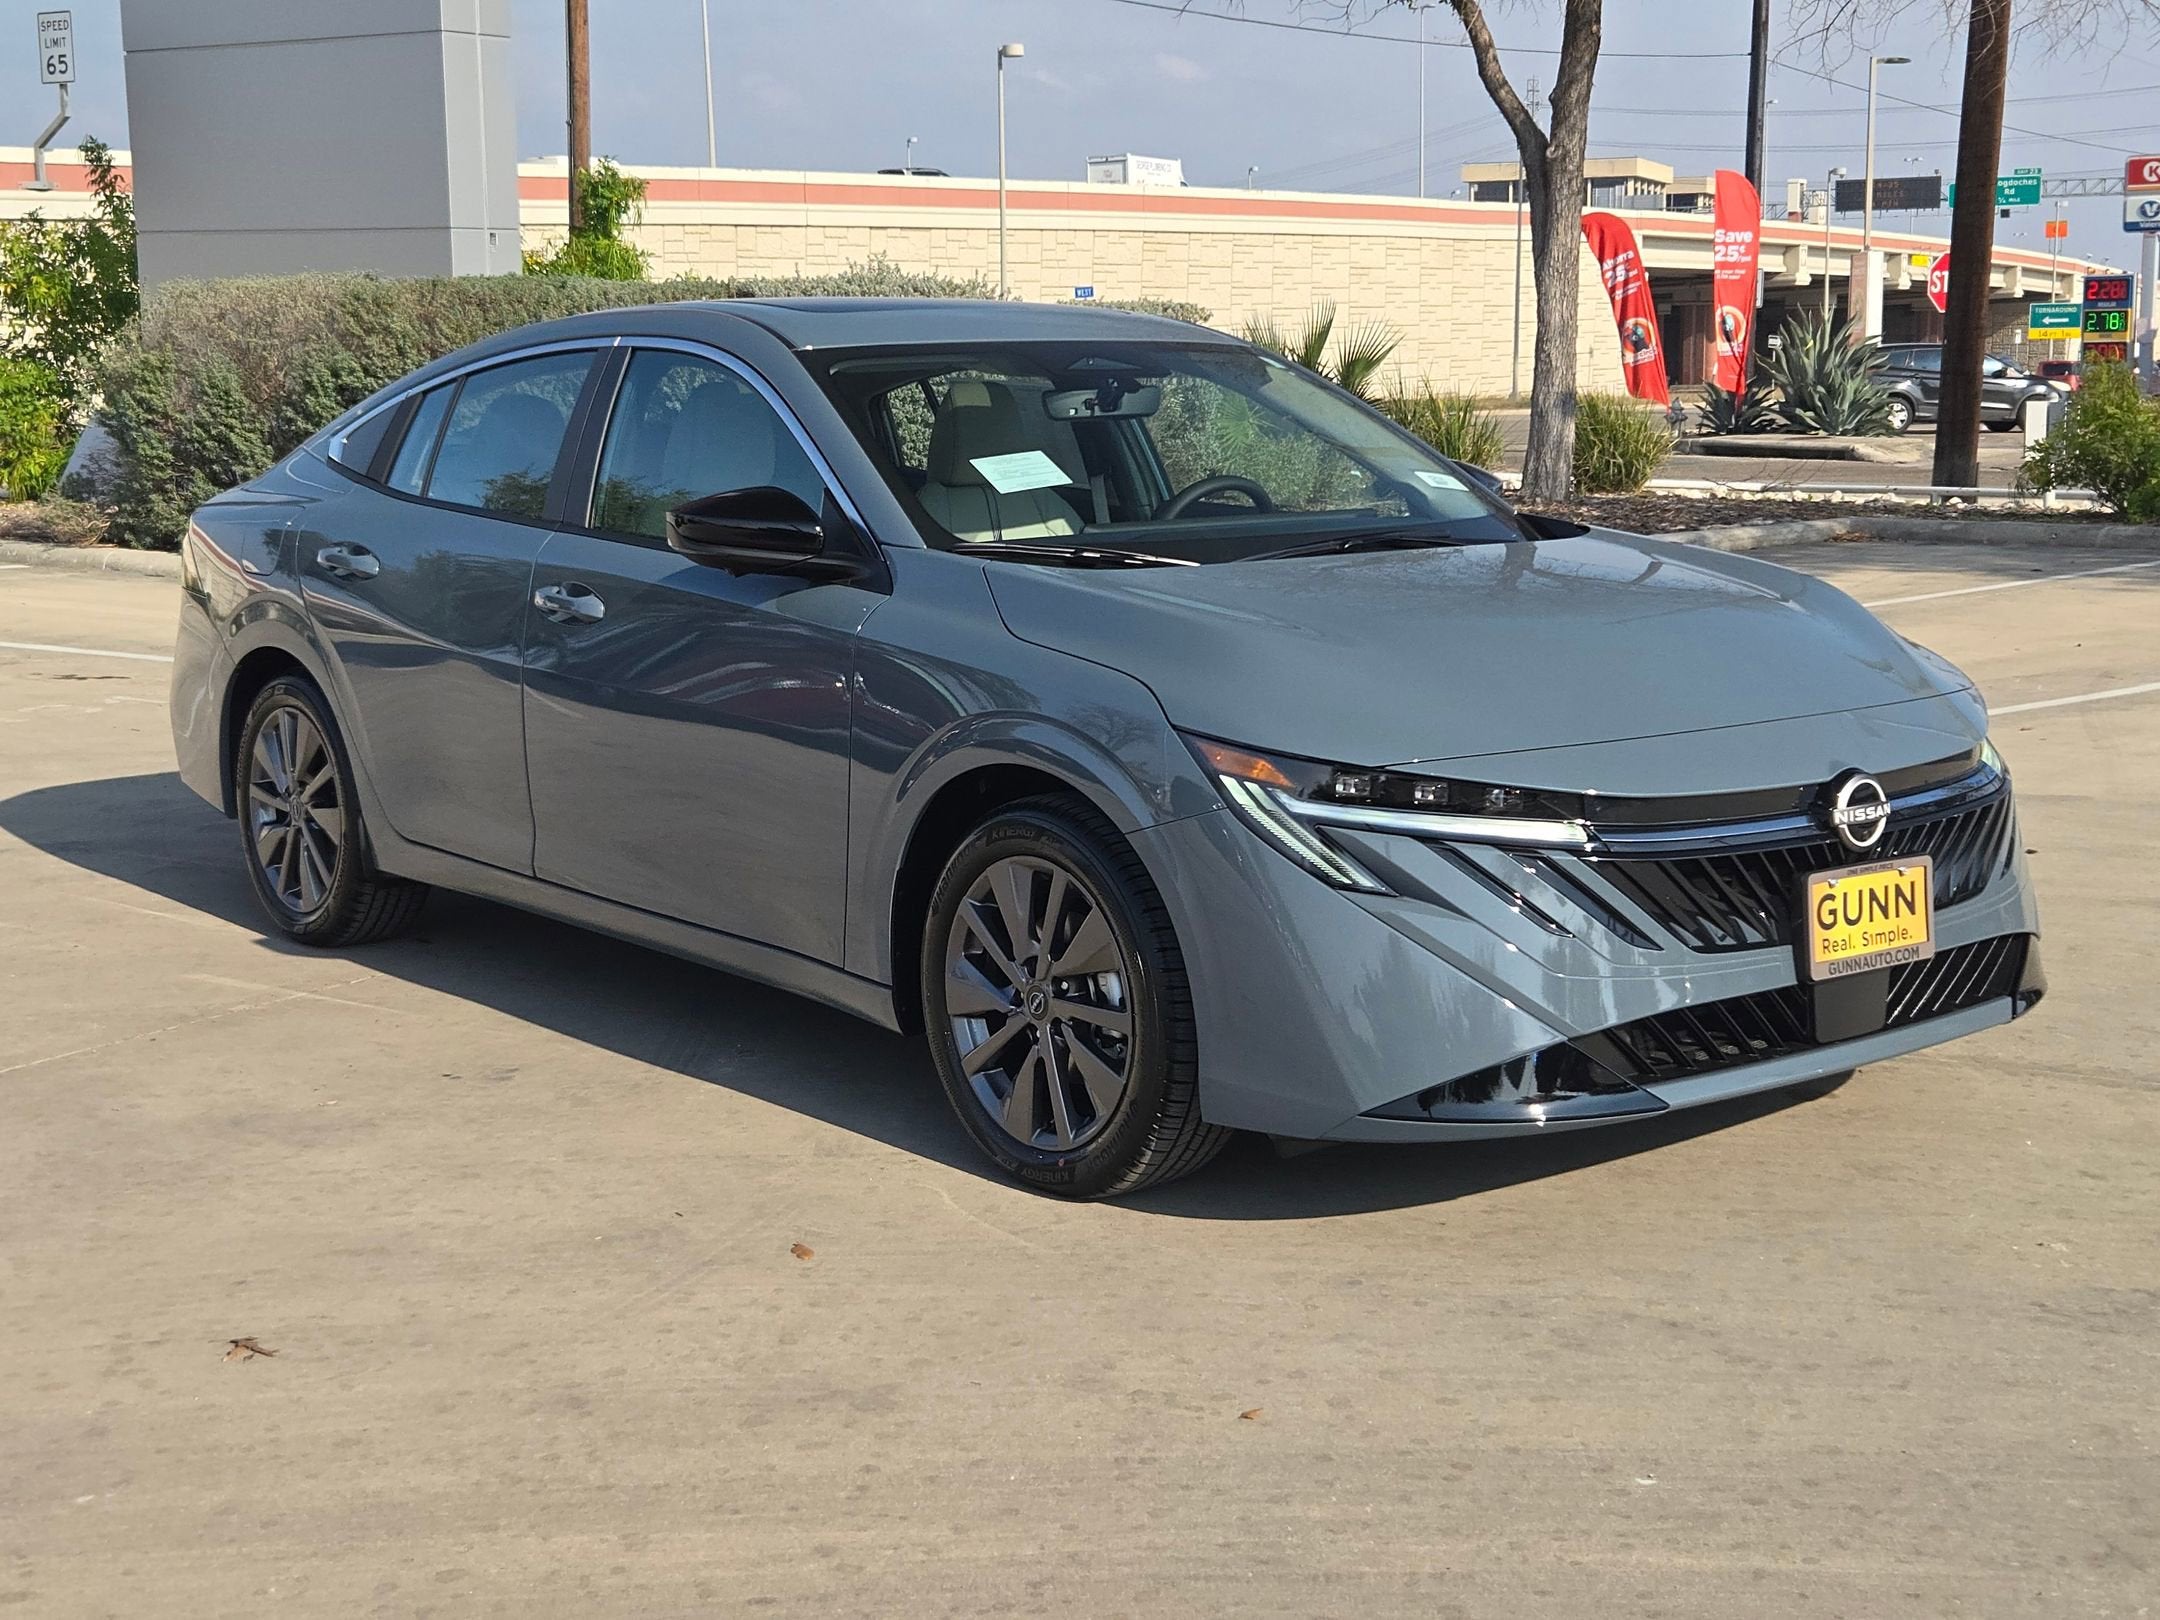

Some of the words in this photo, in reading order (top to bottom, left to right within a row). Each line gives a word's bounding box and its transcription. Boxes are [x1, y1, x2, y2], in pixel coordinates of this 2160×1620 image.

[41, 20, 69, 32] SPEED
[45, 37, 66, 49] LIMIT
[47, 54, 68, 75] 65
[1998, 179, 2037, 188] ogdoches
[1715, 229, 1753, 243] Save
[1931, 270, 1949, 293] ST
[1833, 802, 1891, 824] NISSAN
[1816, 881, 1916, 930] GUNN
[1822, 933, 1856, 954] Real.
[1862, 925, 1913, 947] Simple.
[1828, 946, 1920, 976] GUNNAUTO.COM
